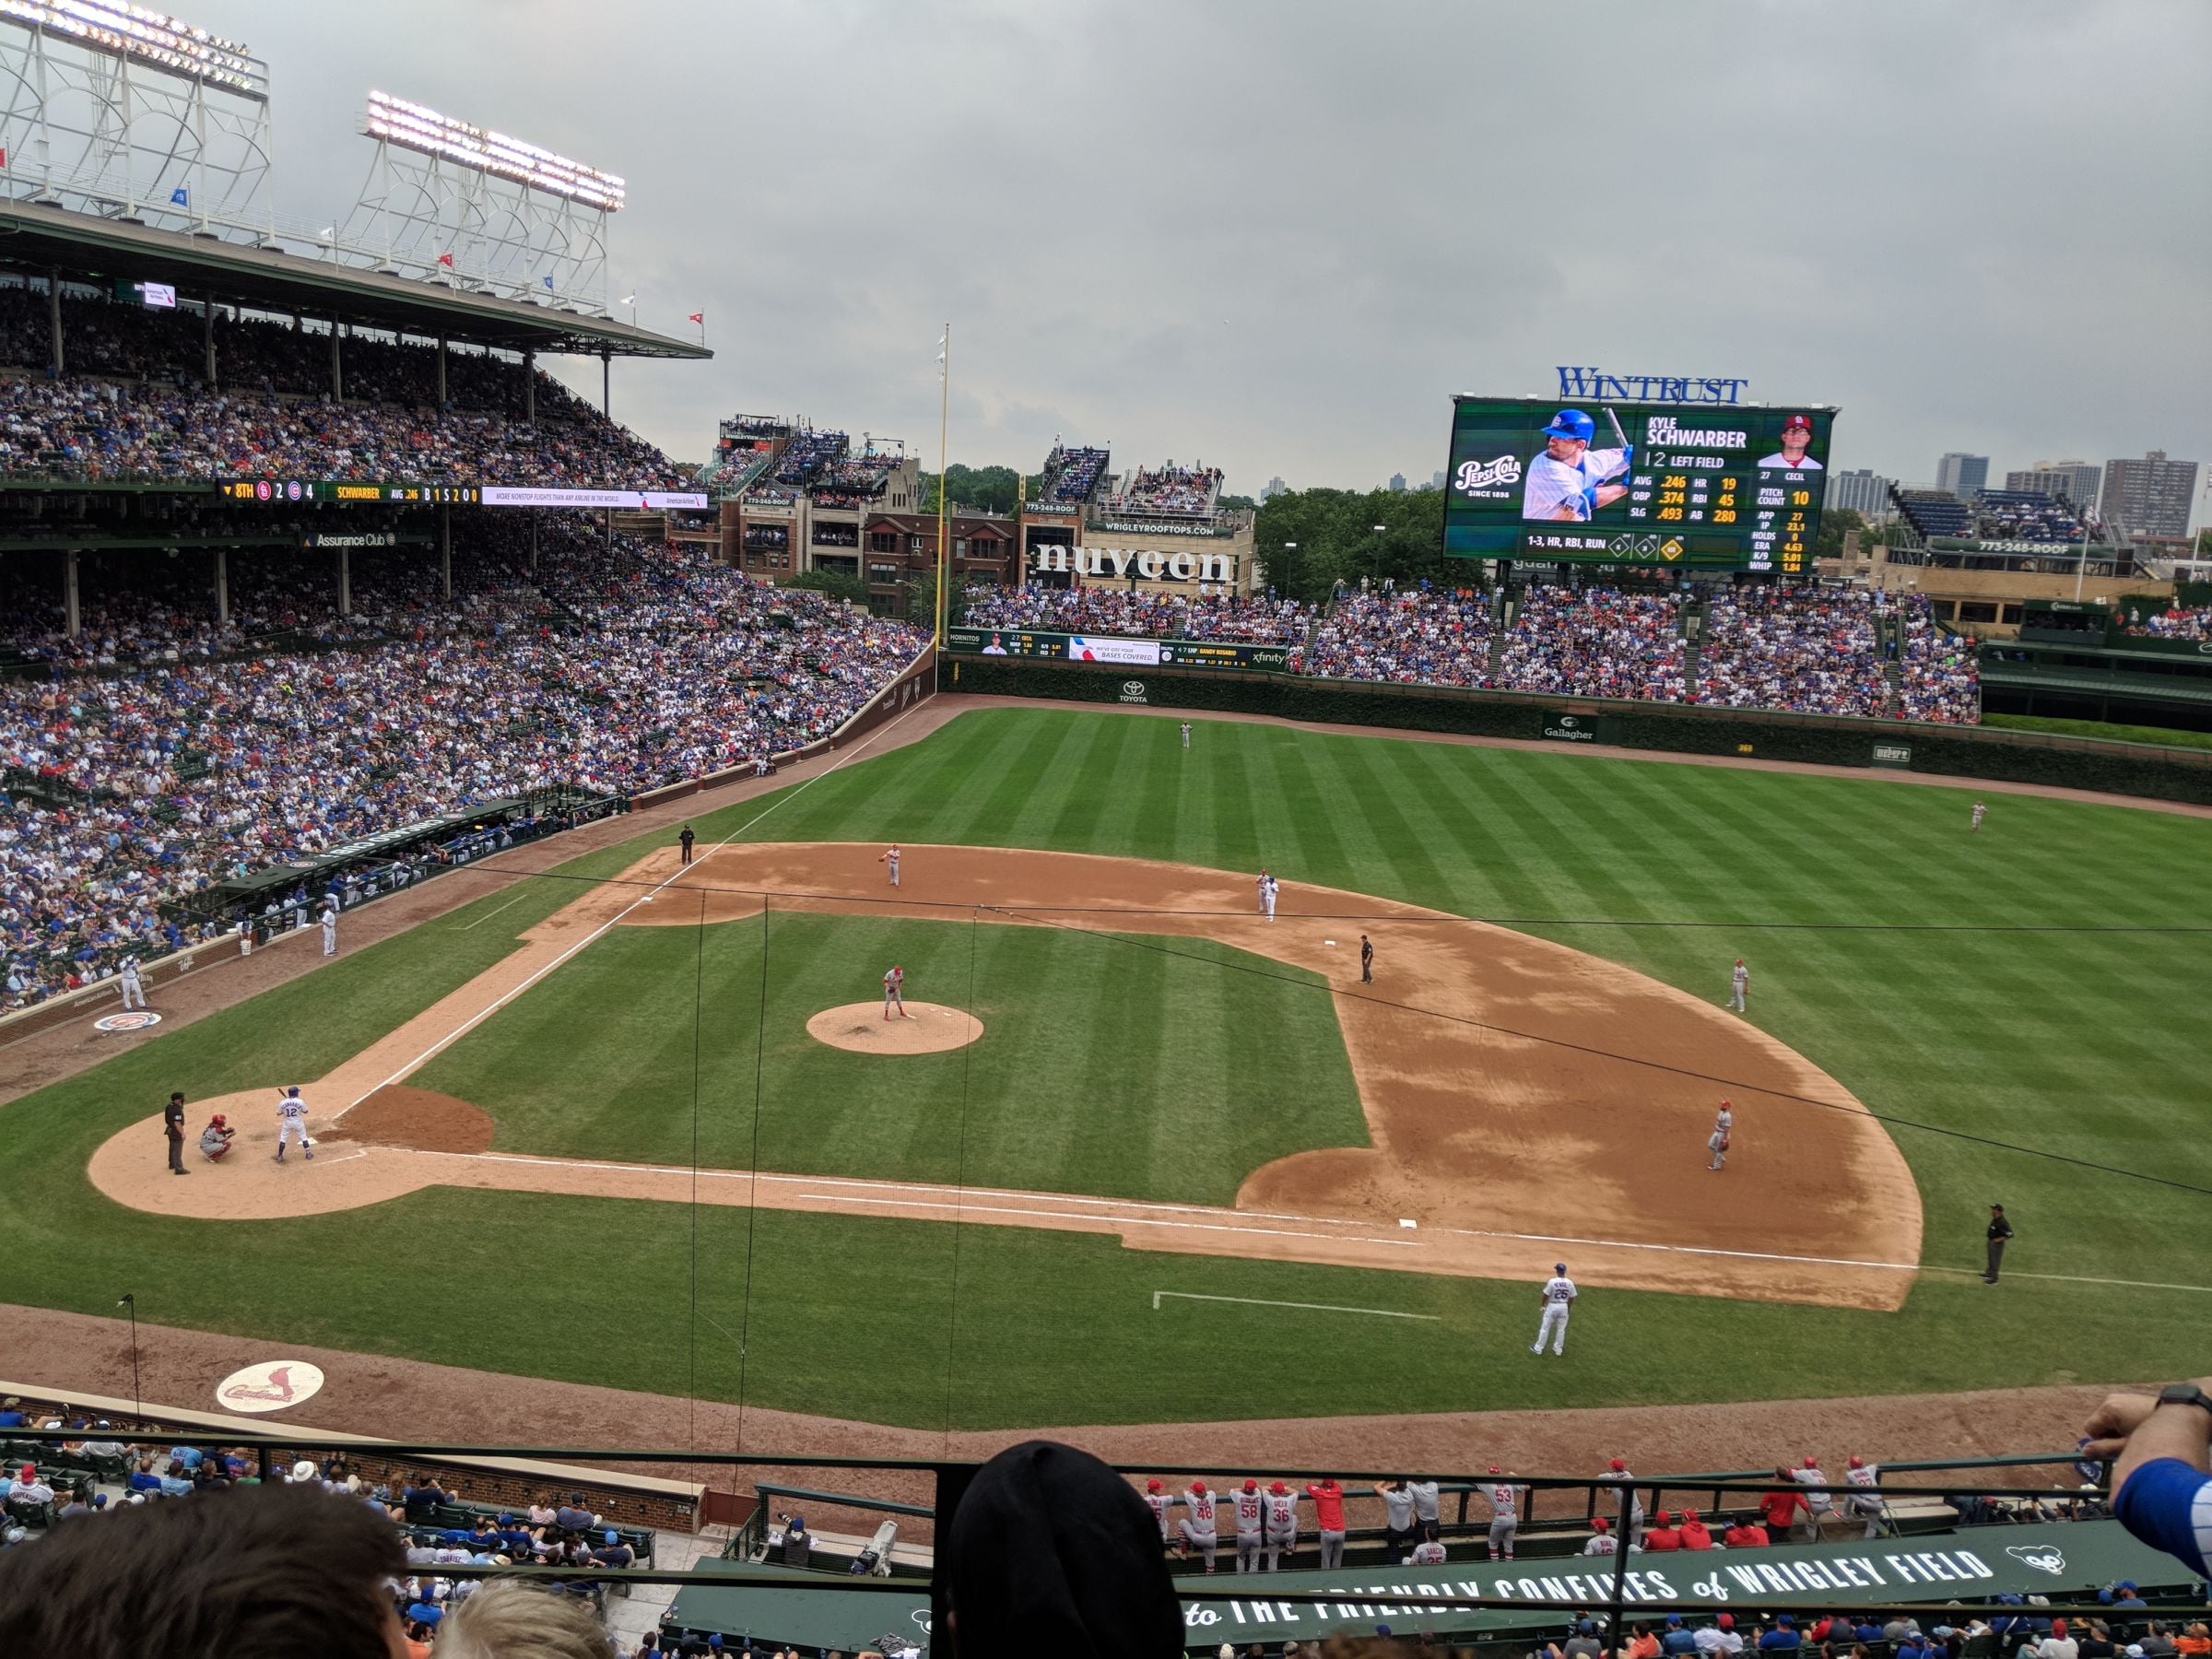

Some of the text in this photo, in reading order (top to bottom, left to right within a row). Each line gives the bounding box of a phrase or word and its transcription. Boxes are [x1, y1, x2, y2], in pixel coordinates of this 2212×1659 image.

[1556, 366, 1748, 404] WINTRUST
[1648, 417, 1677, 429] KYLE
[1646, 429, 1747, 448] SCHWARBER
[1670, 455, 1694, 467] LEFT
[1695, 456, 1724, 468] FIELD
[1633, 475, 1736, 490] AVG .246 HR 19
[1760, 471, 1805, 481] 27 CECIL
[235, 483, 254, 499] 8TH
[276, 483, 283, 499] 2
[306, 485, 313, 500] 4
[337, 486, 381, 500] SCHWARBER
[391, 488, 404, 500] AVG
[406, 488, 418, 500] .246
[425, 488, 430, 500] B
[434, 488, 440, 501] 1
[444, 488, 450, 501] S
[453, 488, 459, 501] 2
[1631, 491, 1735, 506] OBP .374 RBI 45
[1759, 488, 1783, 497] PITCH
[1793, 490, 1810, 505] 10
[1758, 497, 1785, 506] COUNT
[1630, 508, 1736, 523] SLG .493 AB 280
[1757, 512, 1804, 521] APP 27
[1105, 523, 1214, 535] WRIGLEYROOFTOPS.COM
[1761, 522, 1806, 532] IP 23.1
[317, 532, 385, 547] Assurance Club
[1527, 535, 1606, 549] 1-3, HR, RBI, RUN
[1752, 532, 1799, 542] HOLDS 0
[1754, 541, 1803, 552] ERA 4.63
[1979, 542, 2069, 554] 773-248-ROOF
[1036, 543, 1233, 581] nuveen
[1753, 552, 1801, 561] K/9 5.01
[1748, 561, 1801, 571] WHIP 1.84
[950, 633, 980, 642] HORNITOS
[1253, 652, 1285, 664] xfinity
[1544, 727, 1593, 739] Gallagher
[369, 819, 445, 842] CHICAGO
[286, 1108, 298, 1118] 12
[1554, 1288, 1569, 1300] 25
[224, 1384, 294, 1403] Cardinals
[1495, 1488, 1512, 1502] 53
[1197, 1505, 1213, 1520] 48
[1241, 1503, 1258, 1519] 58
[1274, 1509, 1289, 1523] 36
[1185, 1603, 1222, 1627] to
[1692, 1571, 1729, 1602] of
[1725, 1557, 1888, 1594] WRIGLEY
[1885, 1550, 1994, 1583] FIELD
